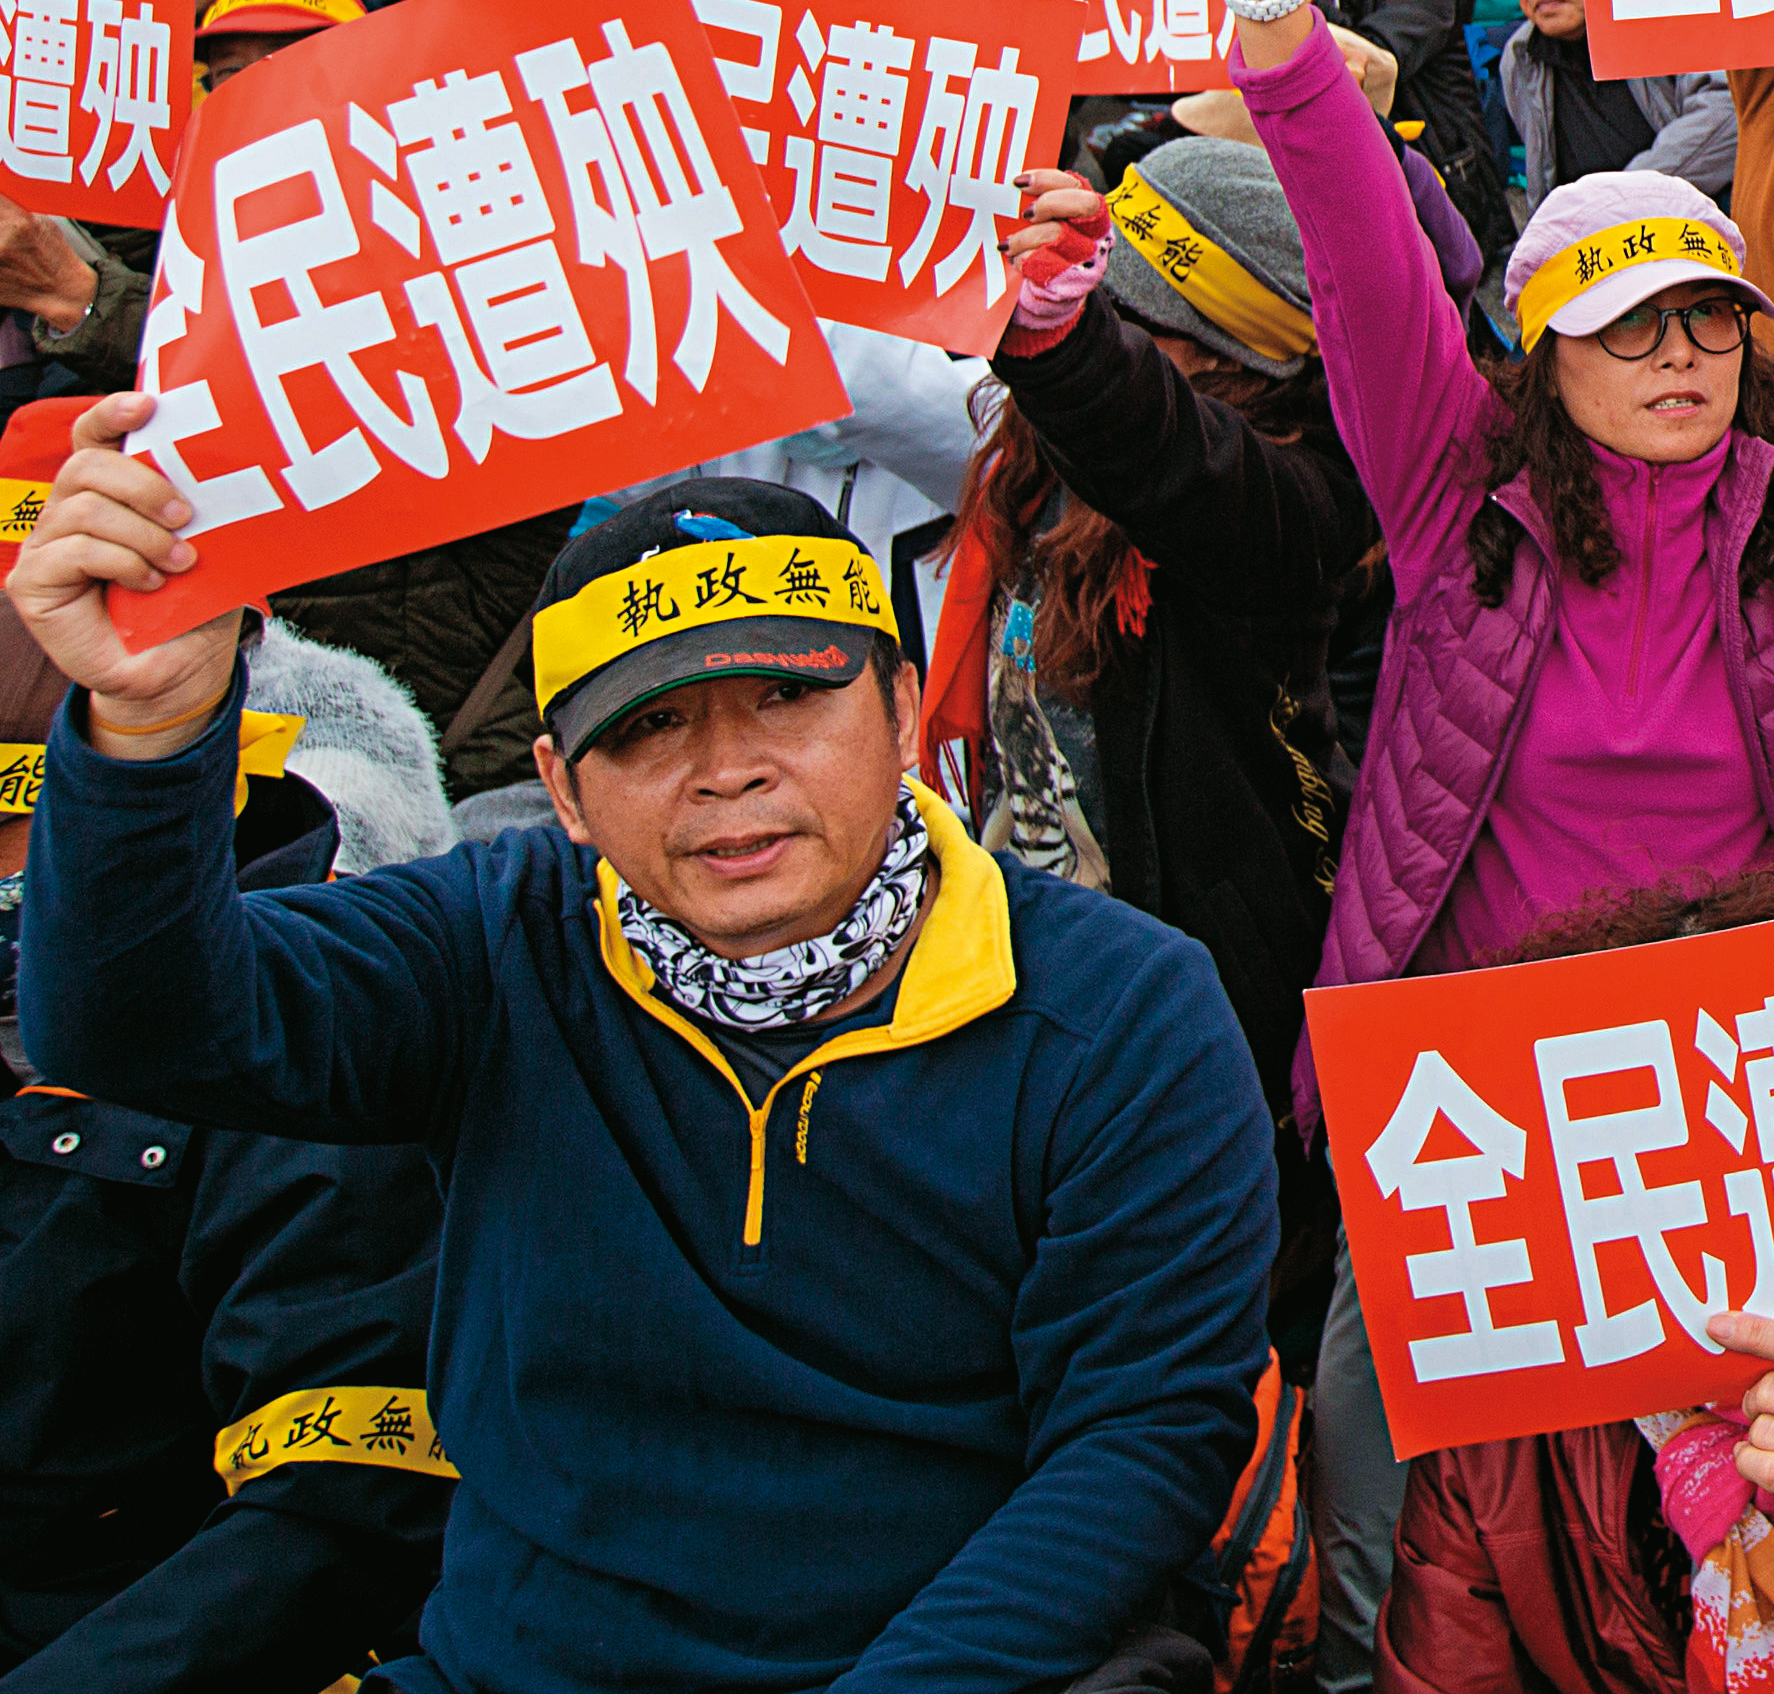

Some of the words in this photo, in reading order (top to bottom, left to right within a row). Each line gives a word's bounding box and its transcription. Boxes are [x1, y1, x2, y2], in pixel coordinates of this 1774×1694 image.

[1573, 220, 1735, 286] 執政無能
[616, 546, 882, 640] 執政無能
